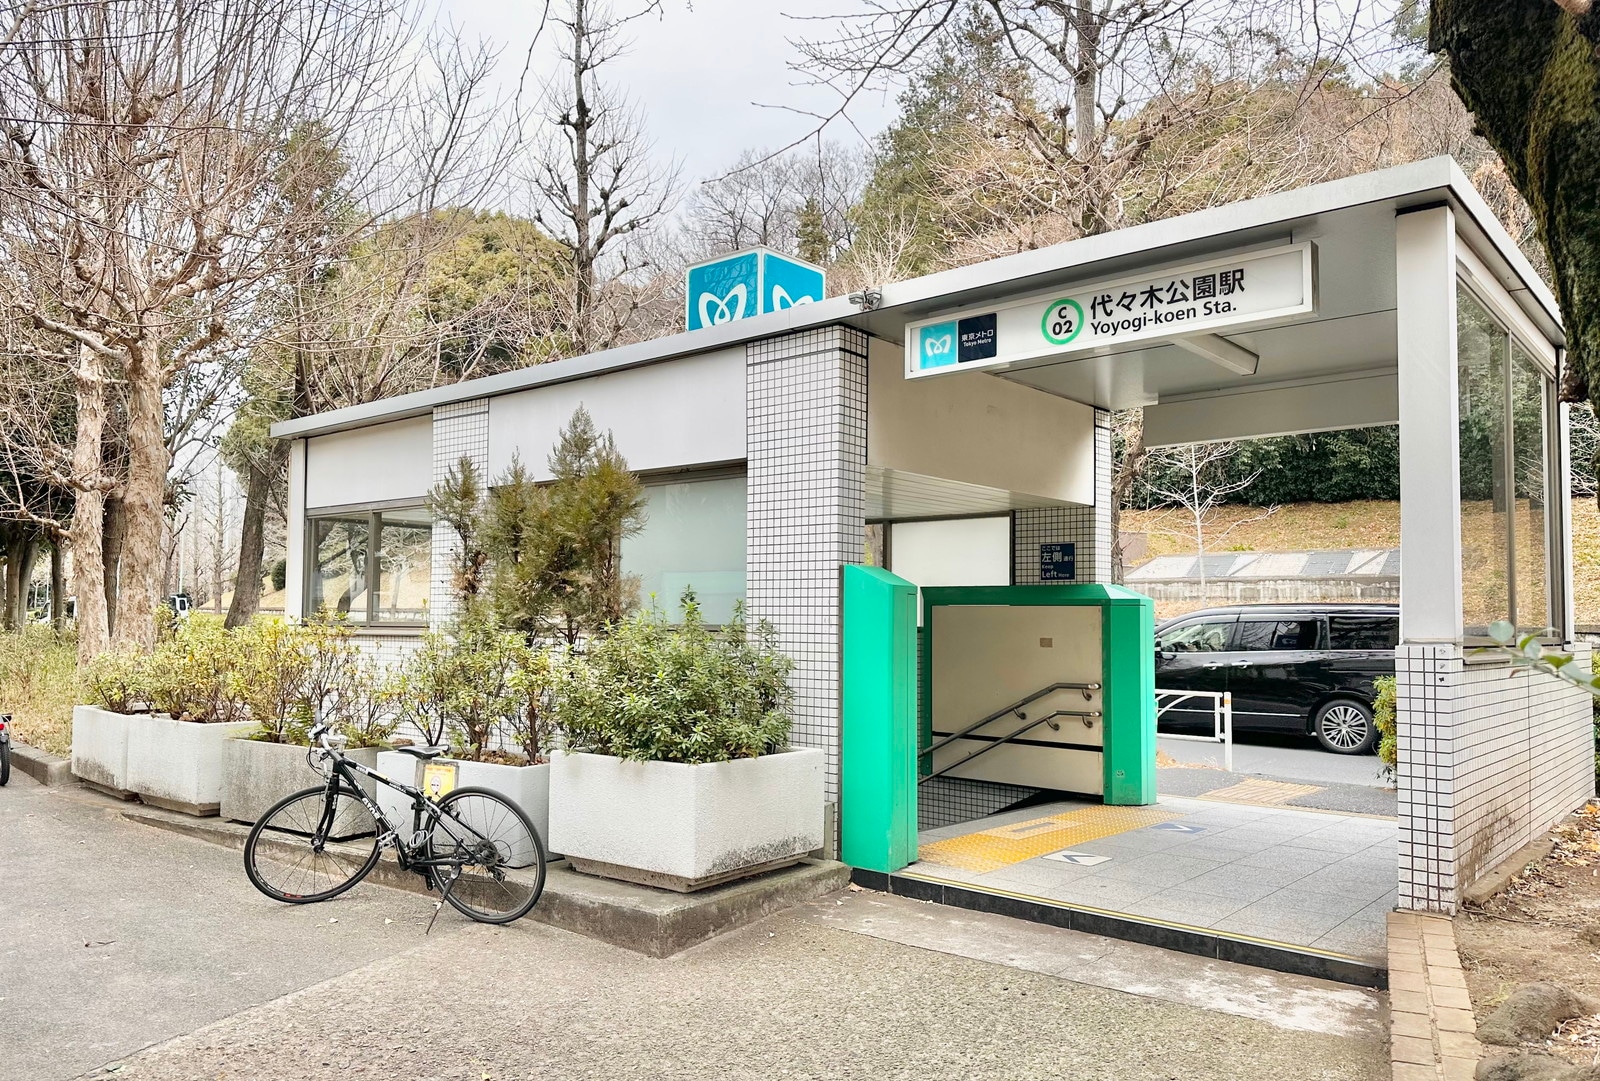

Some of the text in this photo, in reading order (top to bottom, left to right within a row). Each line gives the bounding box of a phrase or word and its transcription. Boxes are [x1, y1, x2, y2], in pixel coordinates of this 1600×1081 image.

[1091, 268, 1245, 320] 代々木公園駅
[1058, 306, 1067, 319] C
[1091, 299, 1237, 336] Yoyogi-koen Sta.
[961, 329, 994, 342] 東京メトロ
[1052, 320, 1073, 336] 02
